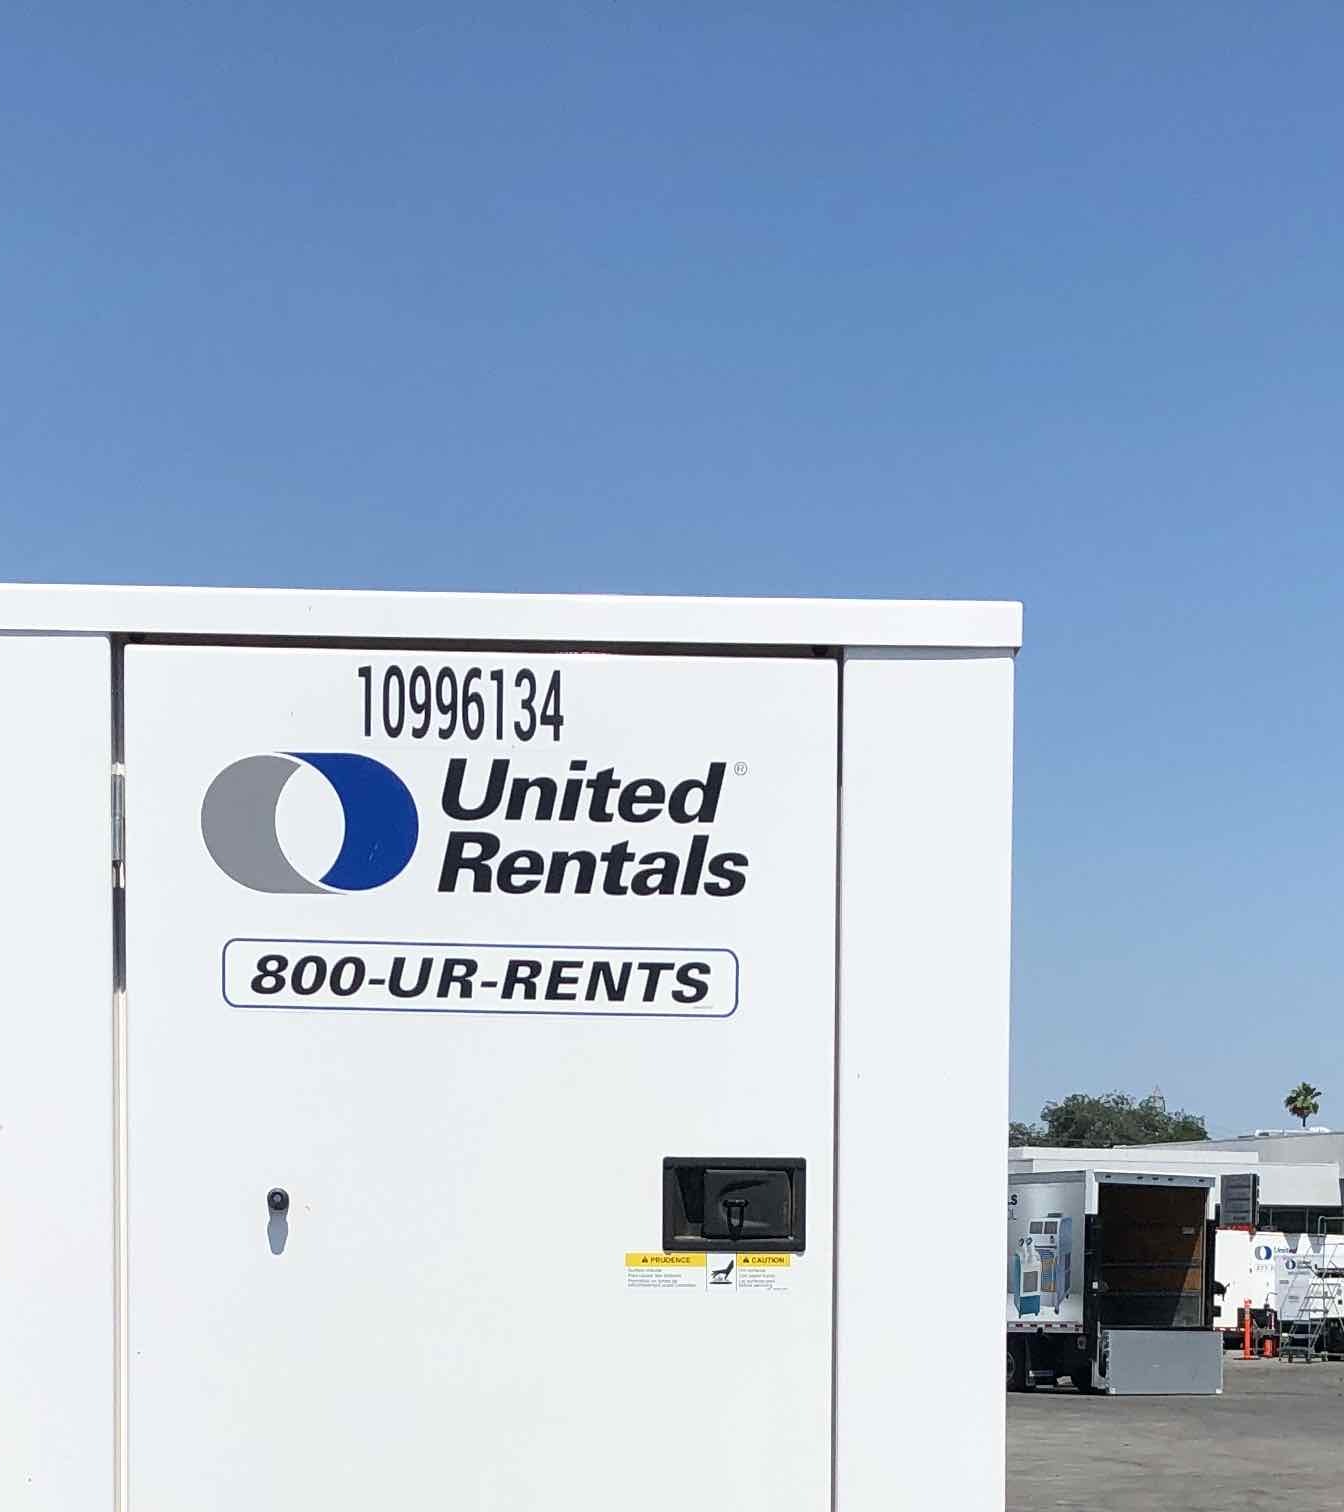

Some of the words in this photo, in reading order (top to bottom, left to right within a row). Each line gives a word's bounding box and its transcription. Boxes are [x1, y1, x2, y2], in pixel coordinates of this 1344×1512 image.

[358, 664, 564, 742] 10996134
[441, 758, 727, 824] United
[437, 831, 749, 897] Rentals
[250, 953, 712, 1005] 800-UR-RENTS
[751, 1256, 785, 1264] CAUTION
